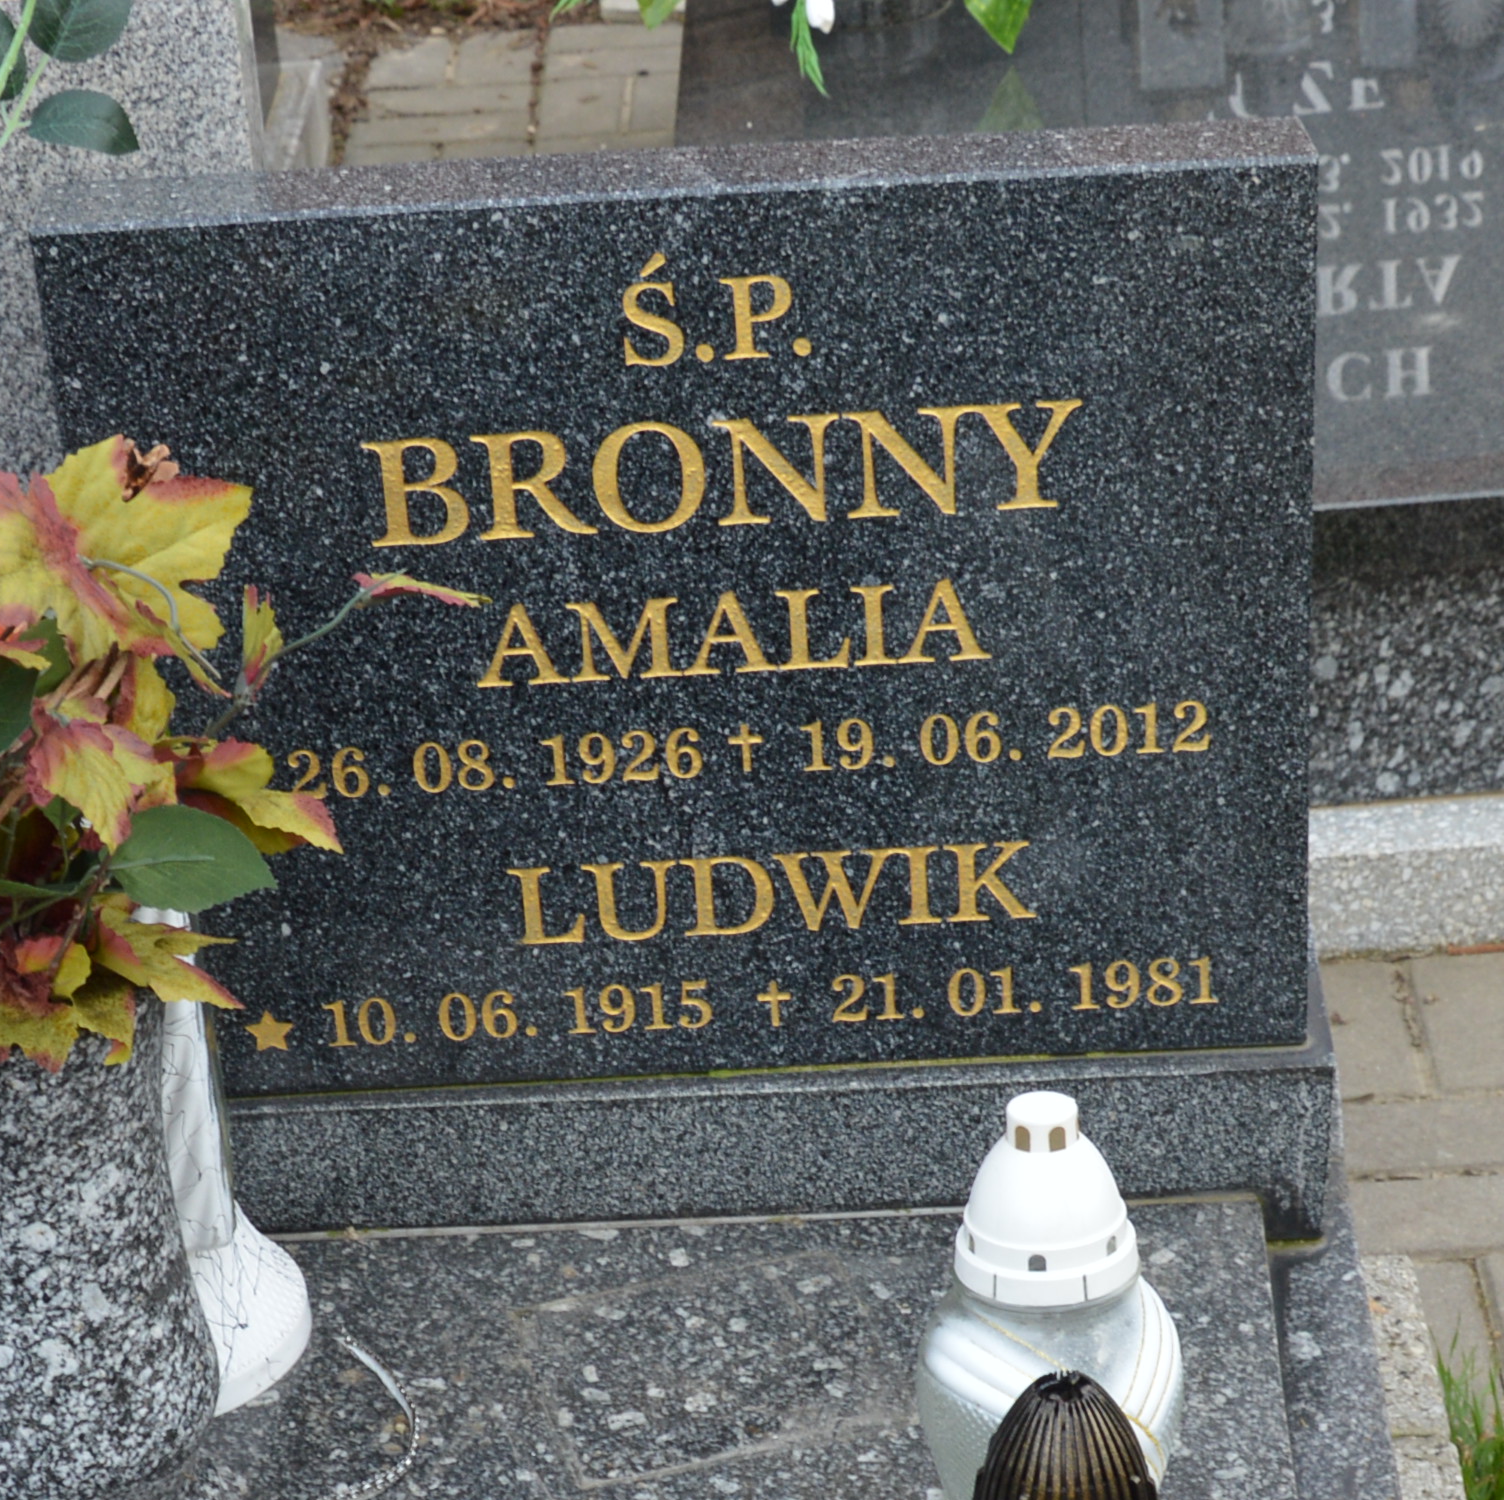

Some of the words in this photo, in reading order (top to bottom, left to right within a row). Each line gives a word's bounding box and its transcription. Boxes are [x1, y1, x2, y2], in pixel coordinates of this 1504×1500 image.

[622, 252, 814, 368] Ś.P.
[361, 399, 1084, 548] BRONNY
[477, 578, 993, 690] AMALIA
[287, 746, 392, 801] 26.
[411, 738, 516, 795] 08.
[540, 726, 703, 788] 1926
[800, 716, 895, 774] 19.
[919, 710, 1022, 767] 06.
[1047, 699, 1212, 759] 2012
[506, 840, 1037, 947] LUDWIK
[321, 996, 418, 1049] 10.
[437, 990, 539, 1043] 06.
[564, 978, 714, 1036] 1915
[831, 973, 925, 1024] 21.
[947, 965, 1044, 1018] 01.
[1070, 955, 1218, 1012] 1981
